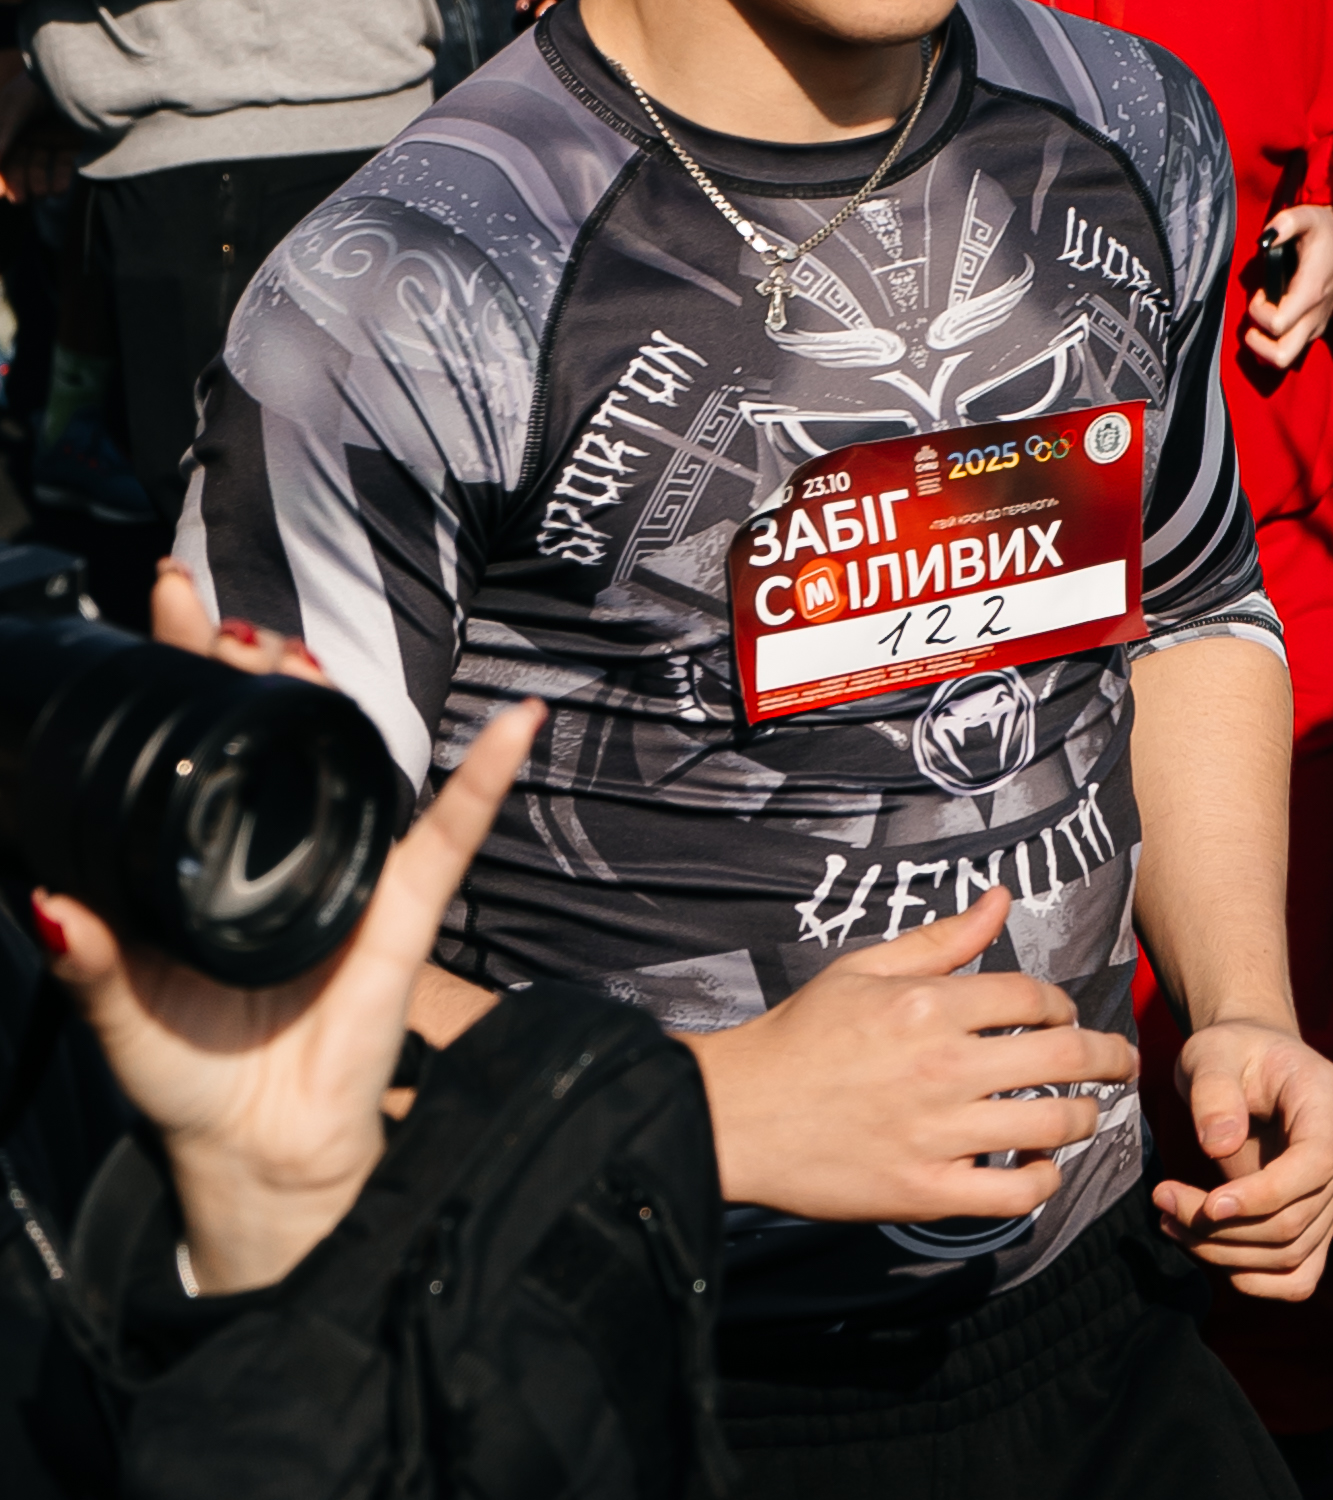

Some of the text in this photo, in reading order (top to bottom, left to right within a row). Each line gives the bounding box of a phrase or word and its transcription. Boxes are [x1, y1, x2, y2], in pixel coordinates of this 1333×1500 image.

[803, 471, 851, 499] 23.10
[947, 441, 1020, 480] 2025
[749, 488, 909, 567] ЗАБІГ
[755, 519, 1064, 627] СМІЛИВИХ
[878, 595, 1012, 657] 122
